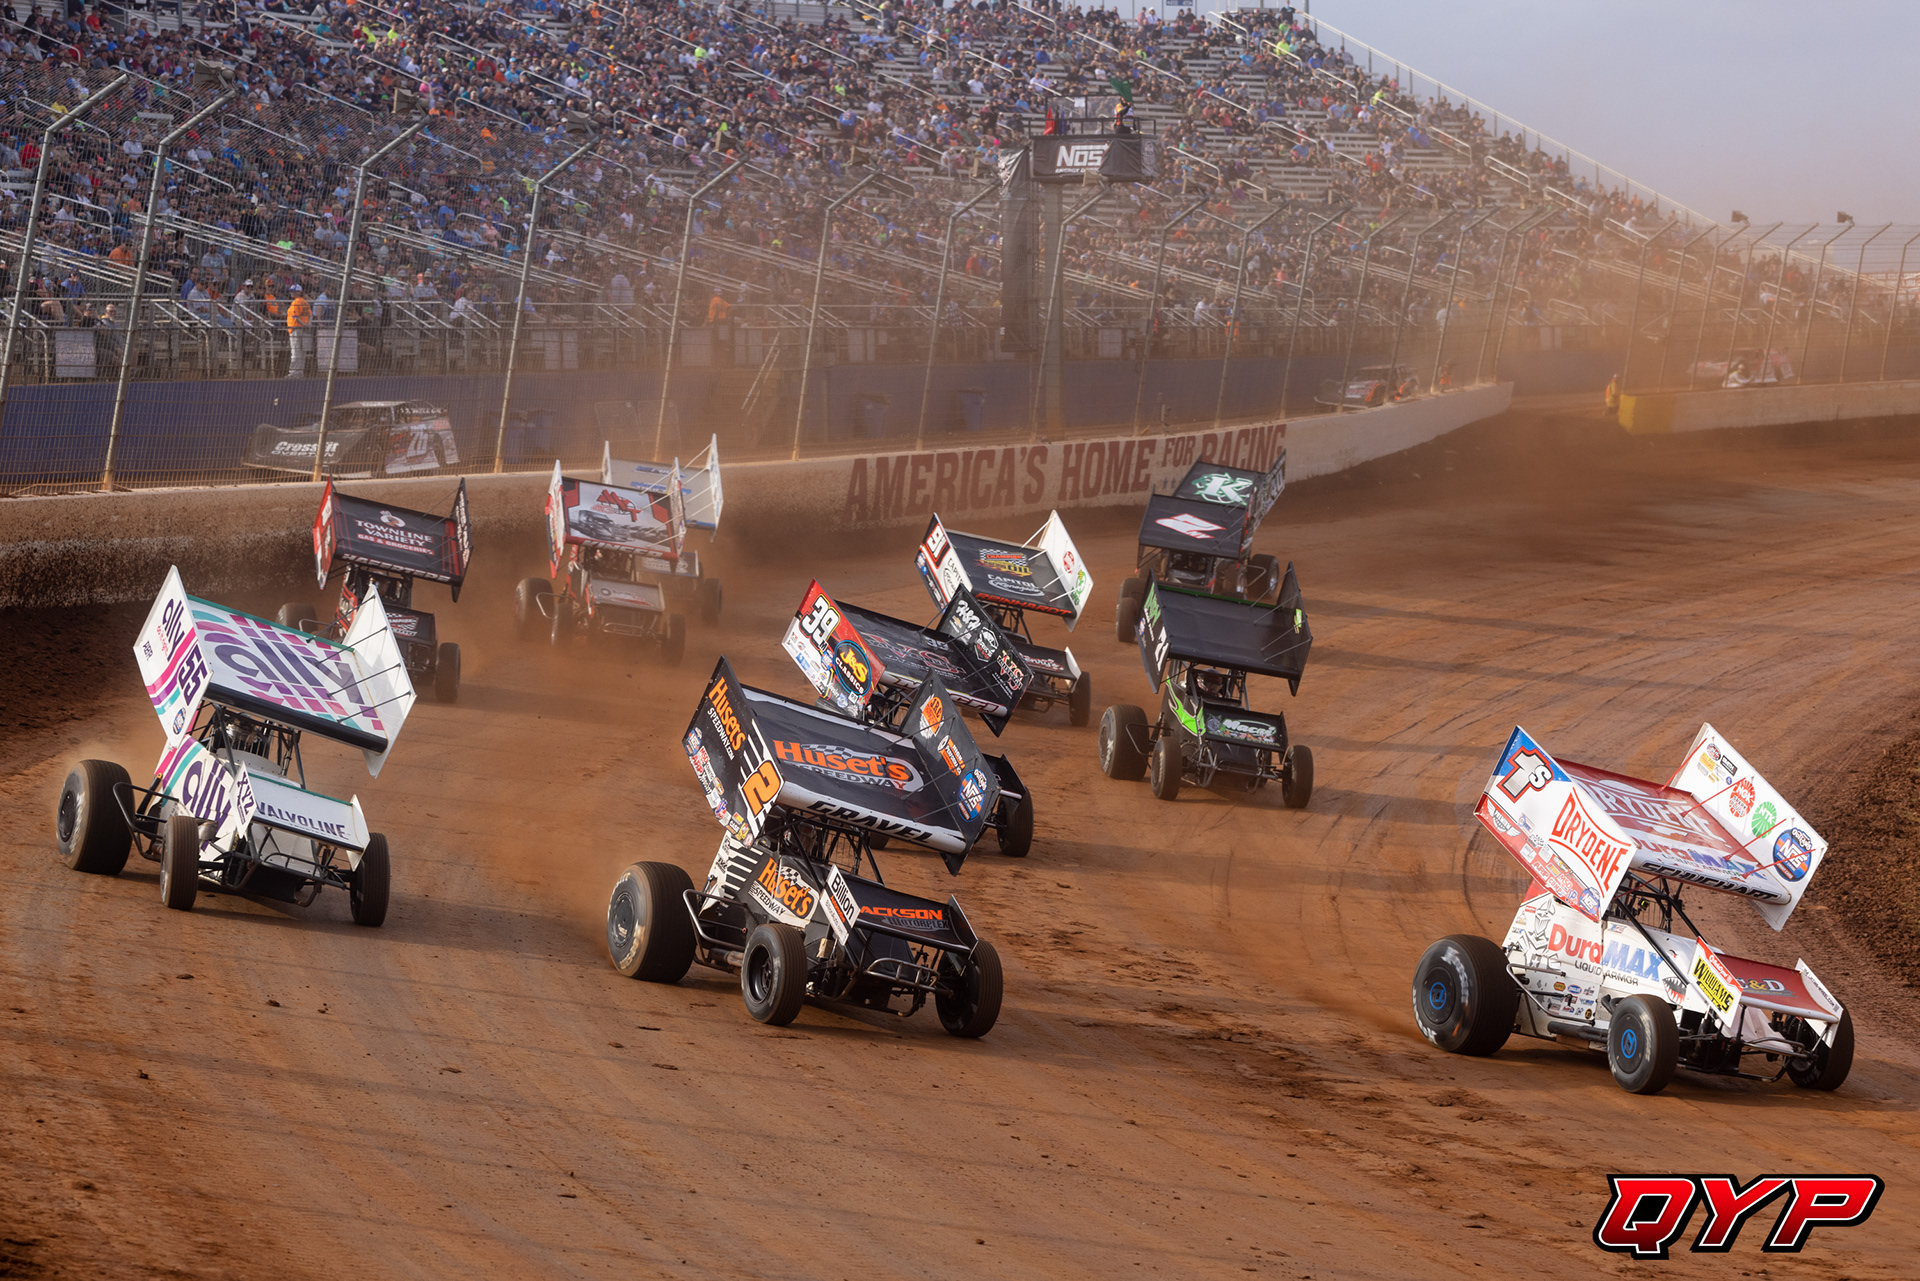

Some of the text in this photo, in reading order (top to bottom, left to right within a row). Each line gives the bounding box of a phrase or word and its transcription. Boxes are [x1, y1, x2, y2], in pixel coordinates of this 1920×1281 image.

[1056, 144, 1104, 167] NOS
[274, 441, 340, 453] Crossit
[847, 445, 1048, 521] AMERICA'S
[1060, 439, 1156, 496] HOME
[1162, 436, 1196, 467] FOR
[355, 520, 434, 543] TOWNLINE
[357, 534, 374, 542] GAS
[385, 540, 434, 555] GROCERIES
[364, 528, 426, 546] VARIETY
[926, 525, 948, 559] 91
[988, 573, 1040, 589] CAPITOL
[975, 593, 1072, 616] REINHARDT
[162, 598, 186, 662] ally
[178, 643, 208, 706] 55
[214, 637, 365, 705] ally
[835, 657, 865, 694] CLASSICS
[708, 676, 746, 751] Husets
[707, 707, 735, 761] SPEEDWAY.COM
[773, 740, 910, 782] Huset's
[743, 759, 781, 816] 2
[1733, 796, 1747, 811] SPARK
[1737, 786, 1754, 803] NGK
[255, 801, 350, 841] VALVOLINE
[807, 800, 933, 843] GRAVEL
[1730, 801, 1745, 816] PLUGS
[1758, 807, 1775, 825] NTK
[1551, 792, 1628, 892] DRYDENE
[1632, 834, 1768, 881] uraMAX
[1534, 861, 1549, 878] ARP
[1558, 874, 1573, 889] MSD
[1643, 862, 1780, 901] SCHUCHART
[754, 887, 785, 916] SPEEDWAY
[758, 857, 812, 918] Huset's
[831, 873, 855, 920] Billion
[860, 905, 943, 920] ACKSON
[887, 917, 949, 929] MOTORPLEX
[1574, 960, 1640, 986] LIQUID ARMOR
[1693, 958, 1734, 1012] WILLIAMS
